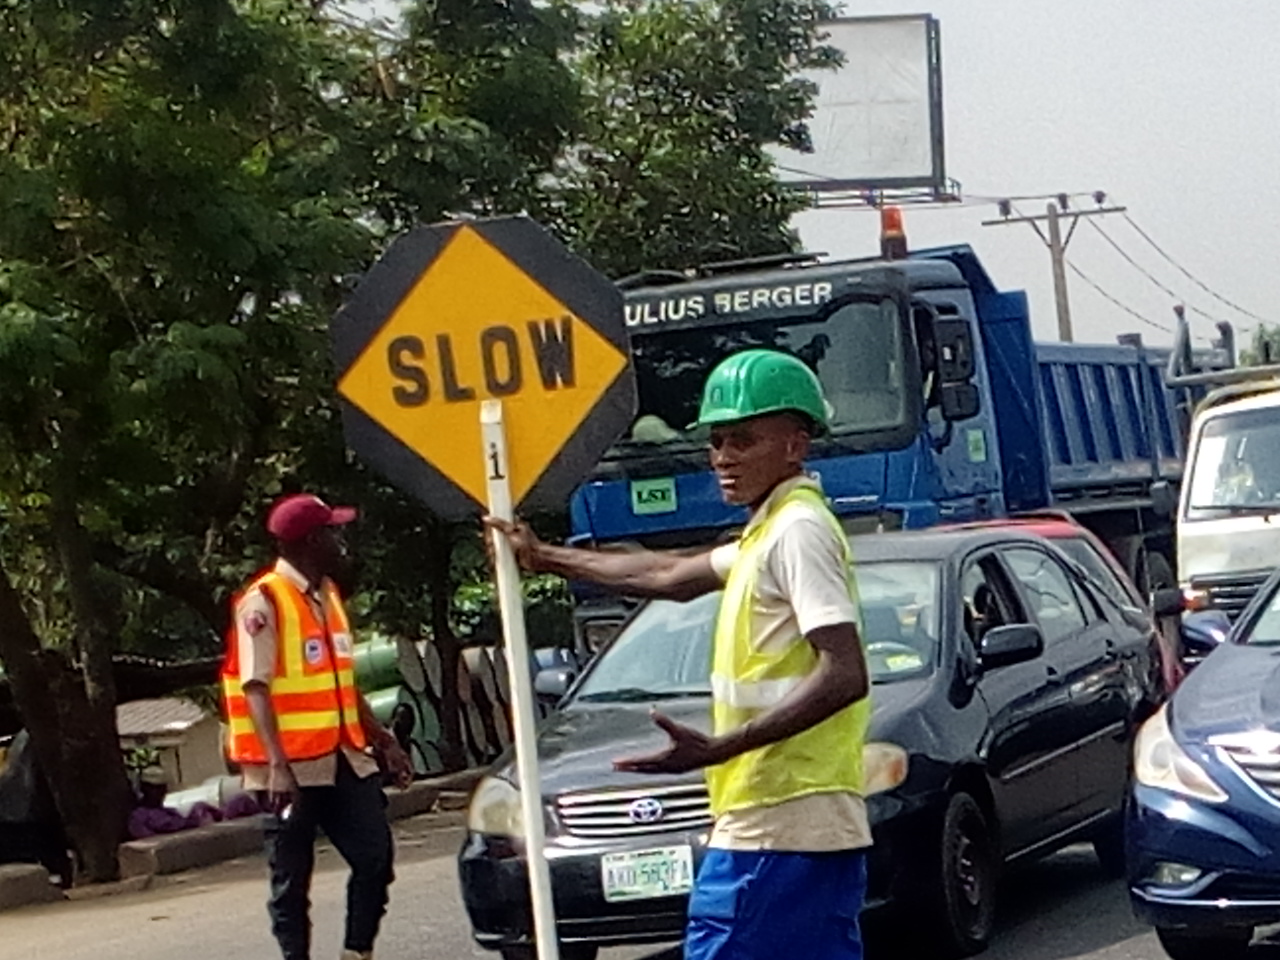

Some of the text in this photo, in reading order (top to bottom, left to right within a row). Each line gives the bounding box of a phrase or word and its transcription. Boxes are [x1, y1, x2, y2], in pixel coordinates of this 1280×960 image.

[623, 282, 833, 327] ULIUS BERGER
[387, 315, 577, 409] SLOW
